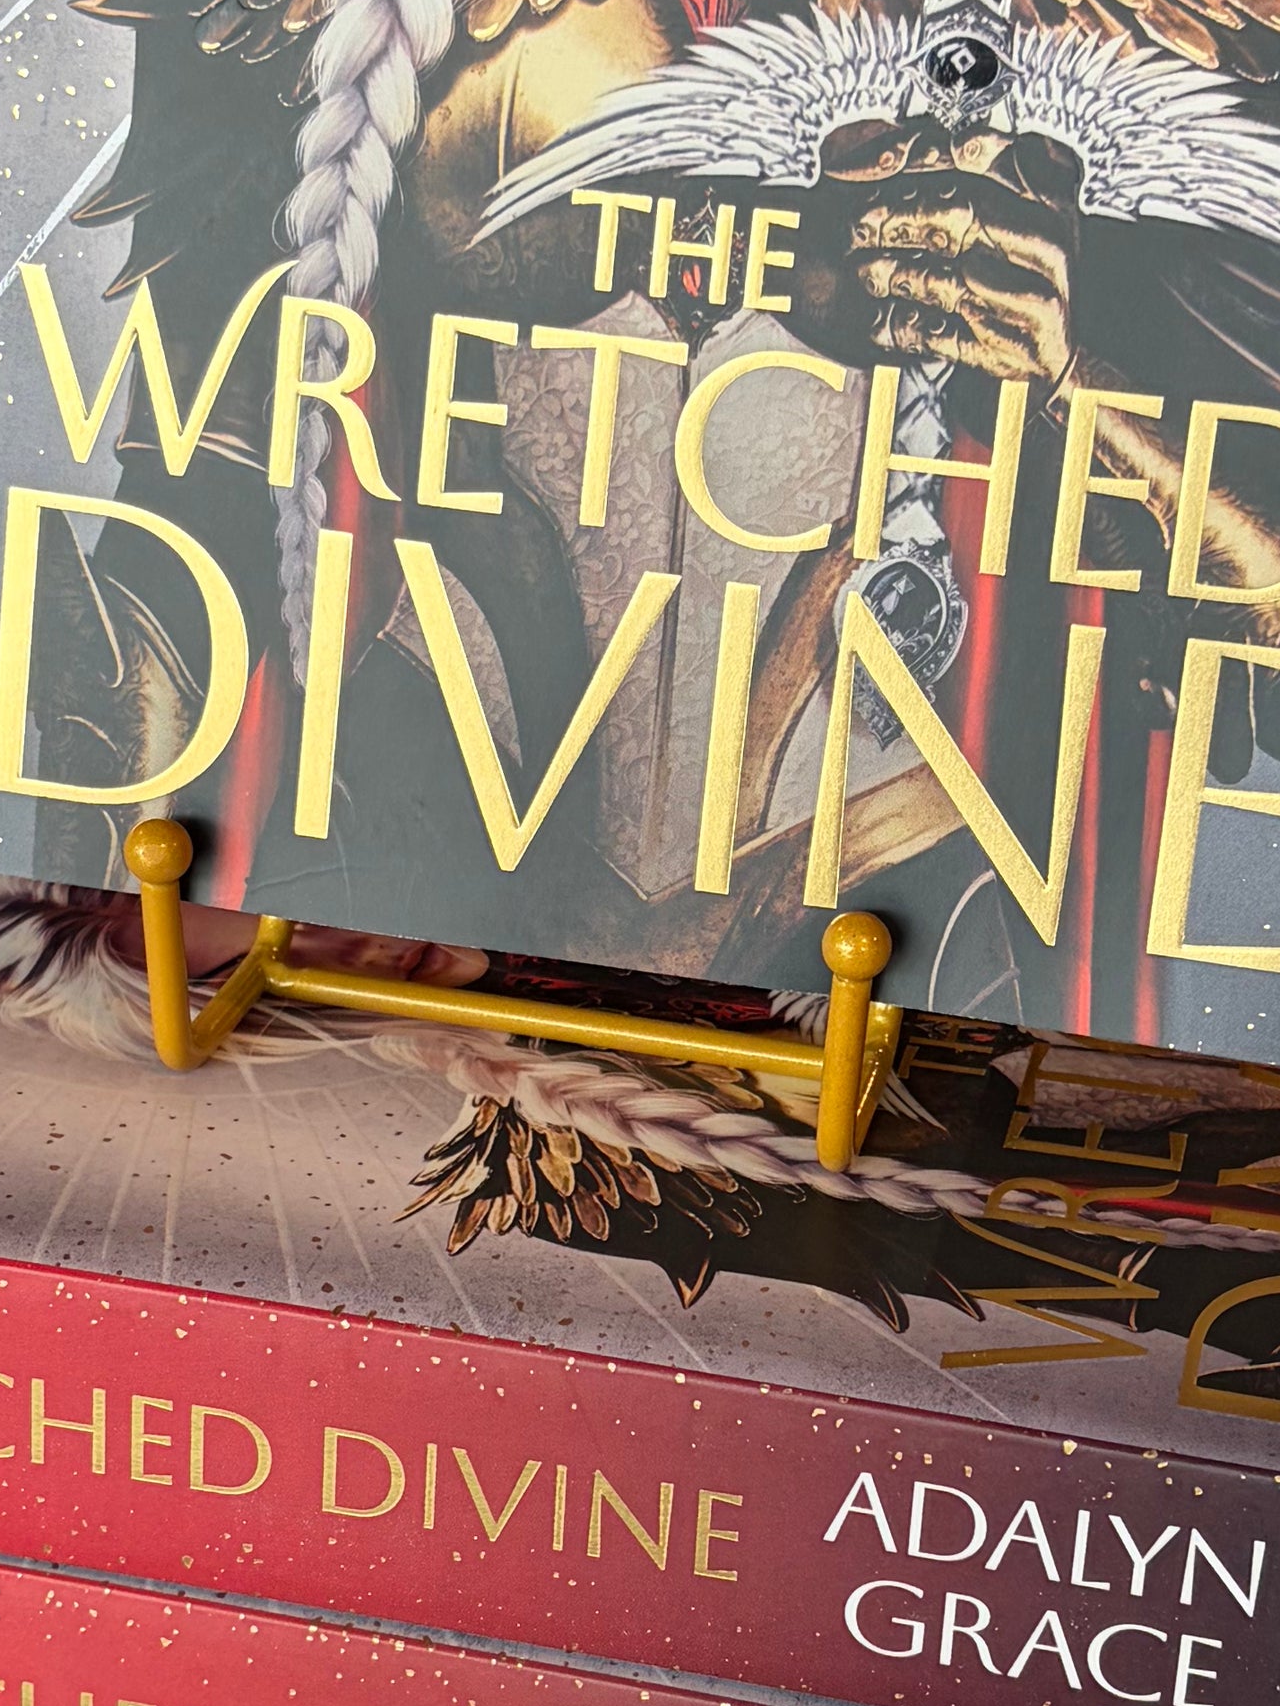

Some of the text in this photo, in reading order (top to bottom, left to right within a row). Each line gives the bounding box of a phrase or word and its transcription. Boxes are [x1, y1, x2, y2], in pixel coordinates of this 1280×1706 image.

[571, 188, 803, 314] THE
[322, 1426, 744, 1583] DIVINE
[823, 1472, 1266, 1617] ADALYN
